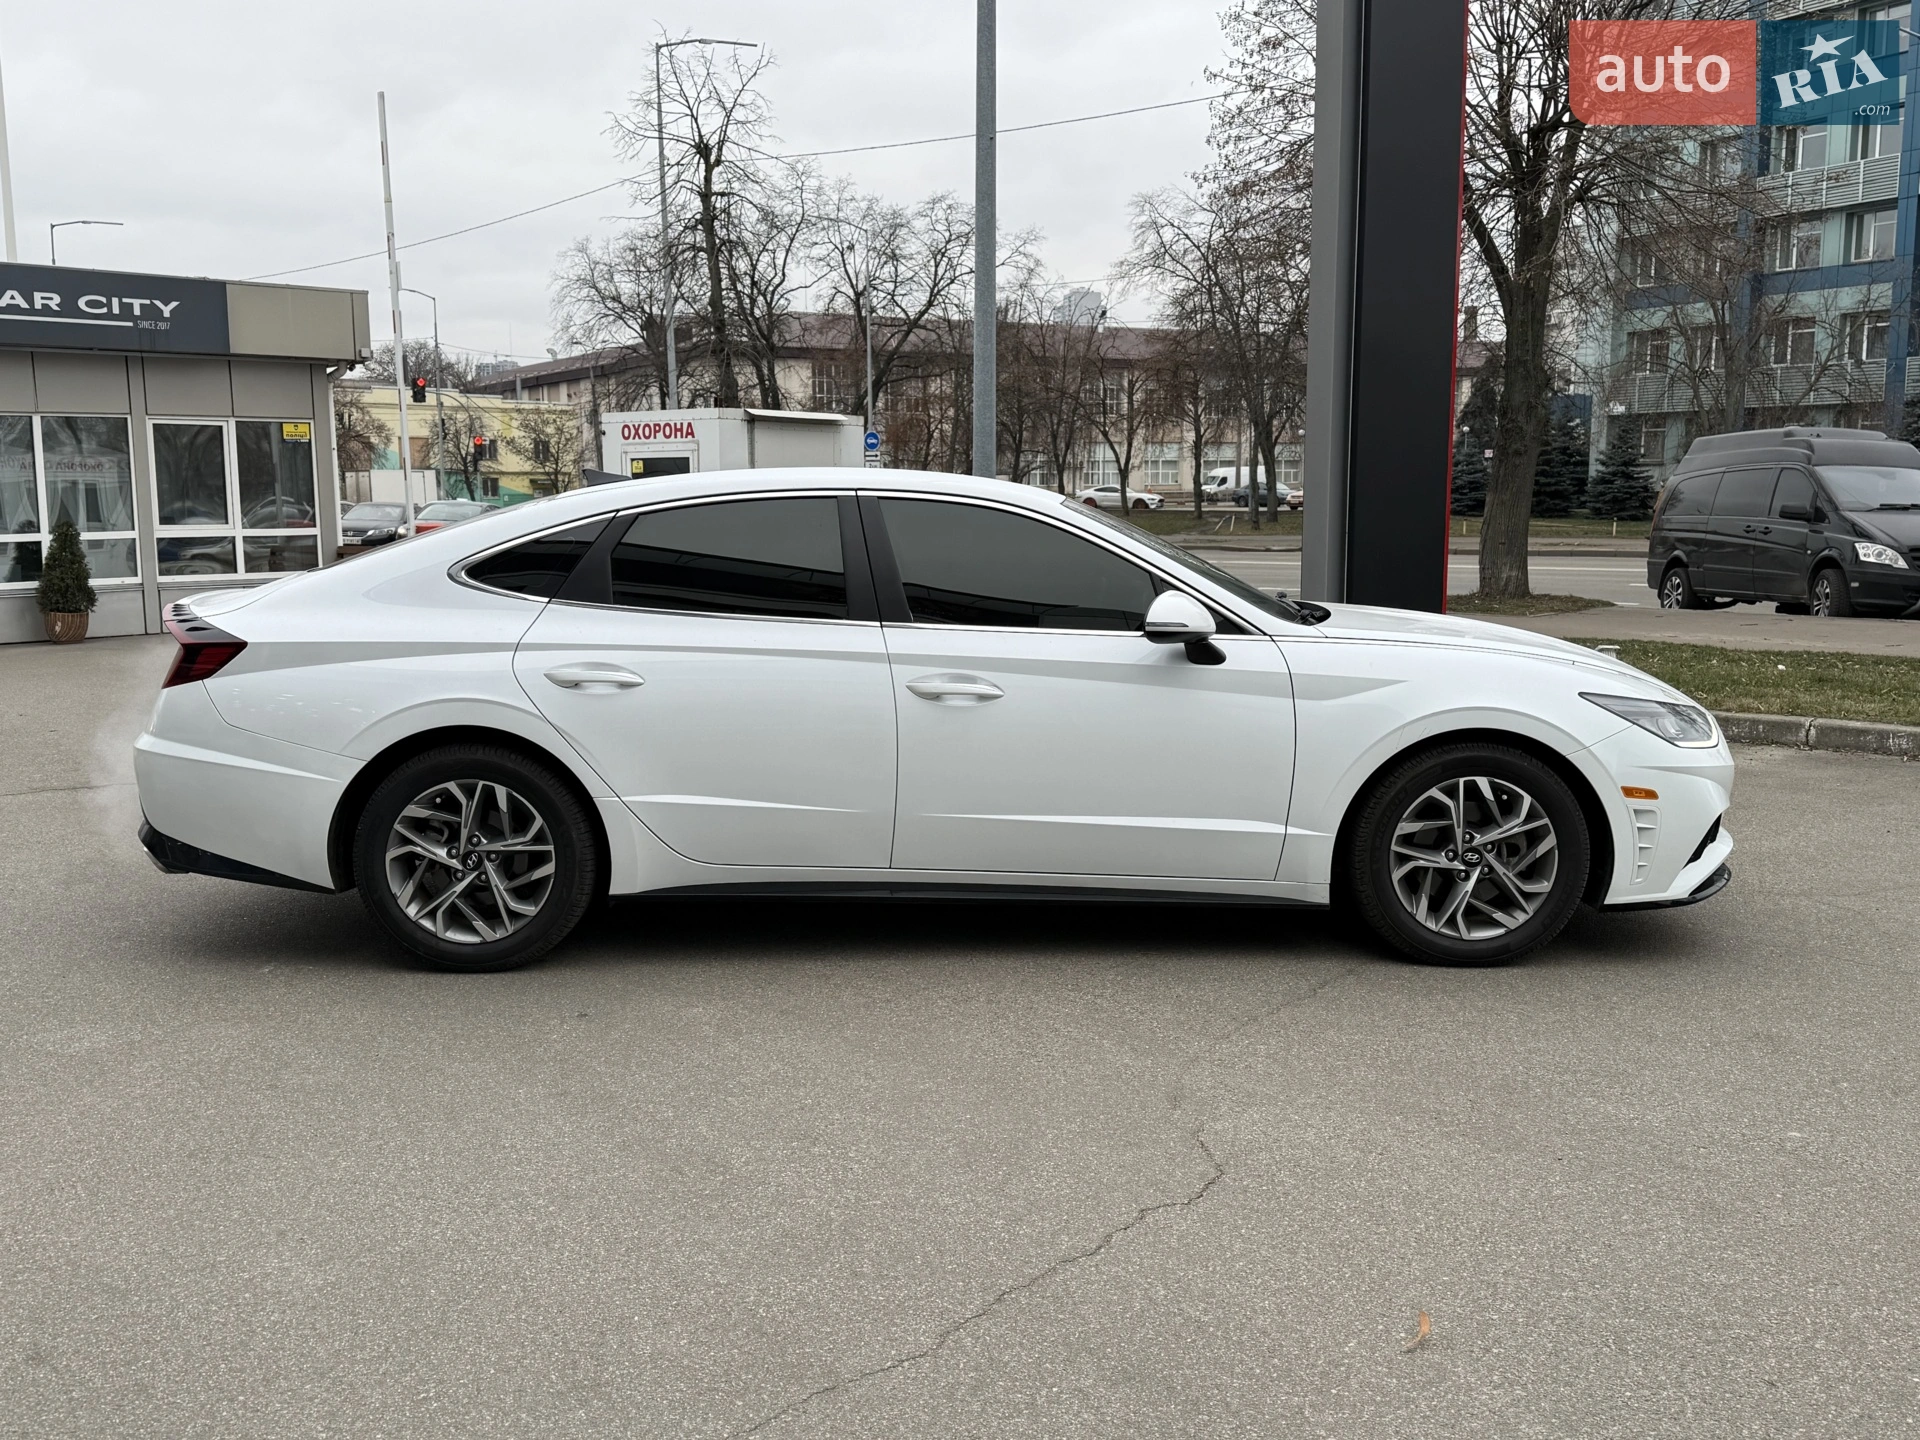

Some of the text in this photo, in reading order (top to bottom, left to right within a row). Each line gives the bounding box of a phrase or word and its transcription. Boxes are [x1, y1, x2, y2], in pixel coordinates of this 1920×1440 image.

[77, 294, 181, 318] CITY
[137, 320, 171, 331] SINCE 2017
[621, 421, 696, 441] ОХОРОНА
